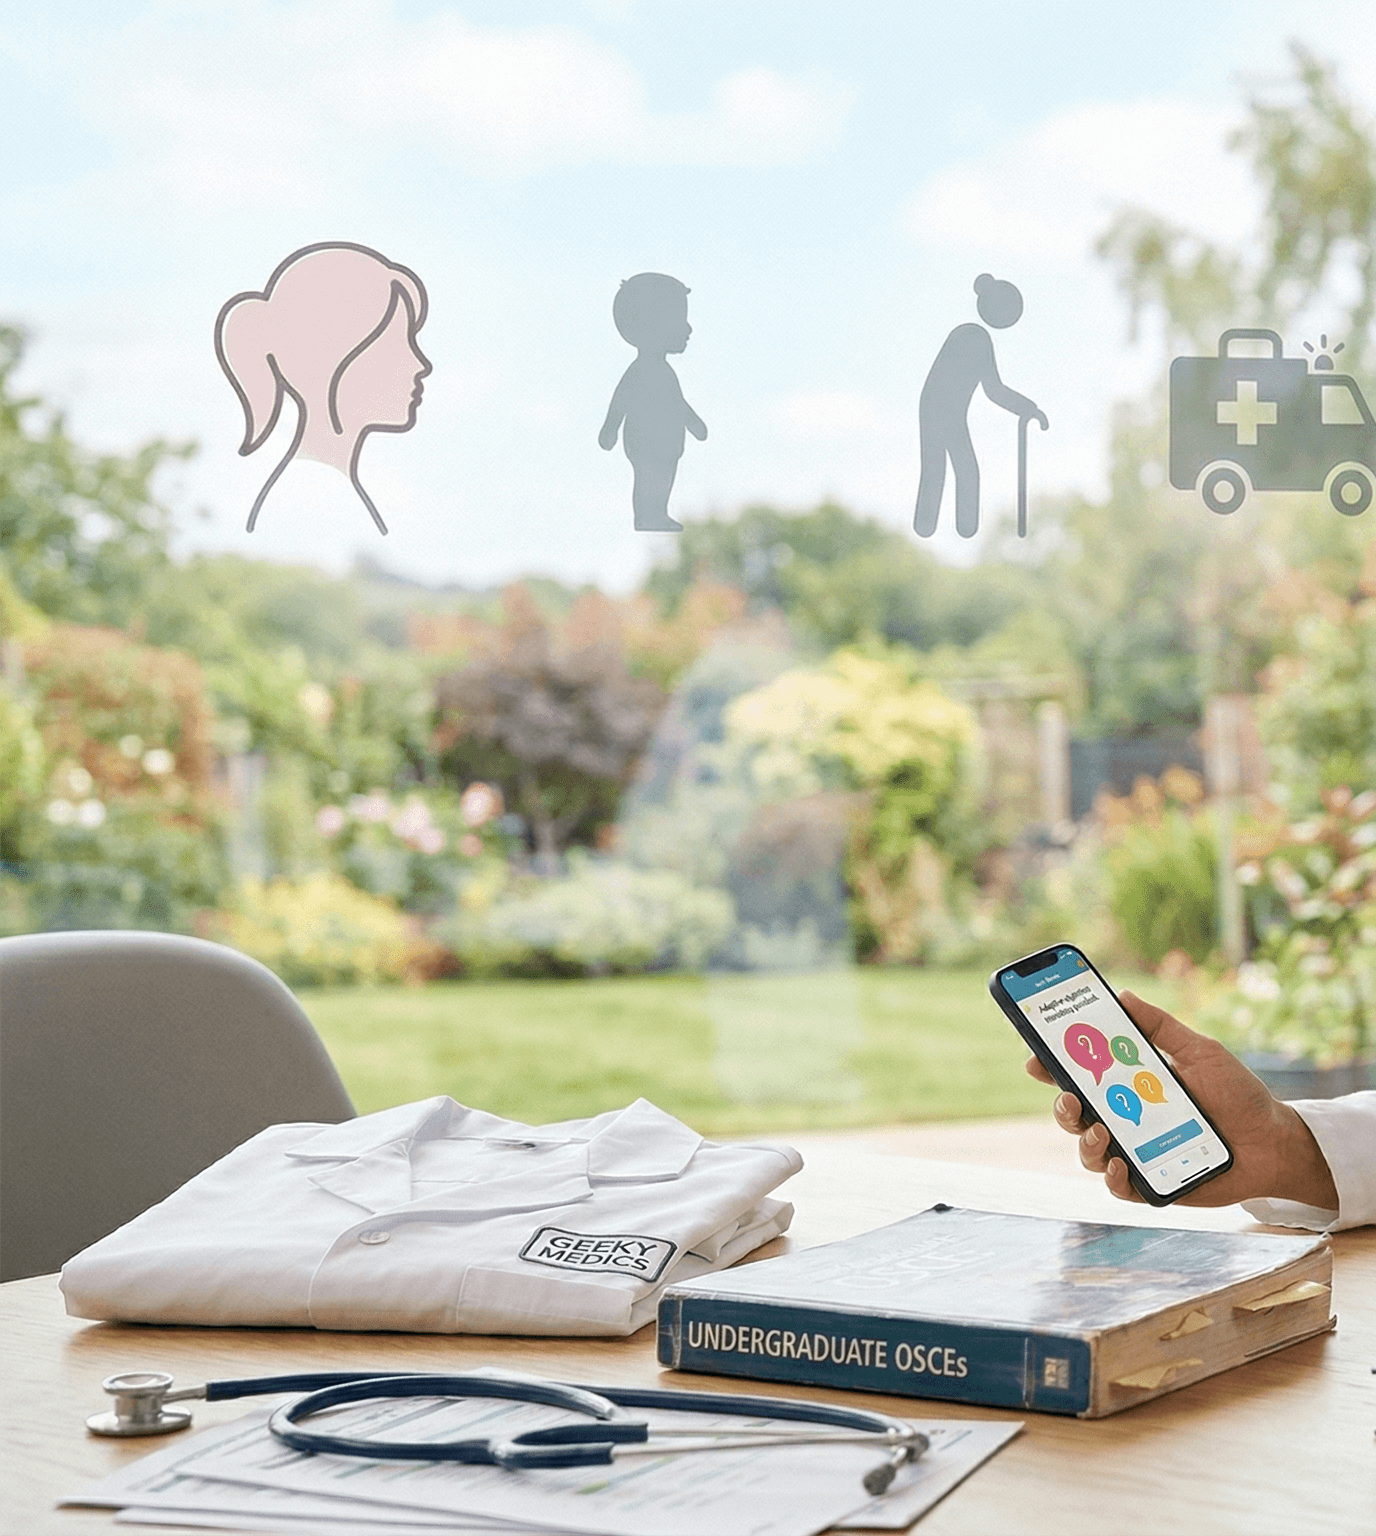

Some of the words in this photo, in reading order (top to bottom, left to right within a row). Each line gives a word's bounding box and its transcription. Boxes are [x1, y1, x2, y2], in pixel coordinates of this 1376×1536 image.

[537, 1246, 650, 1271] MEDICS
[550, 1236, 658, 1257] GEEKY
[688, 1320, 888, 1369] UNDERGRADUATE
[895, 1342, 968, 1378] OSCEs
